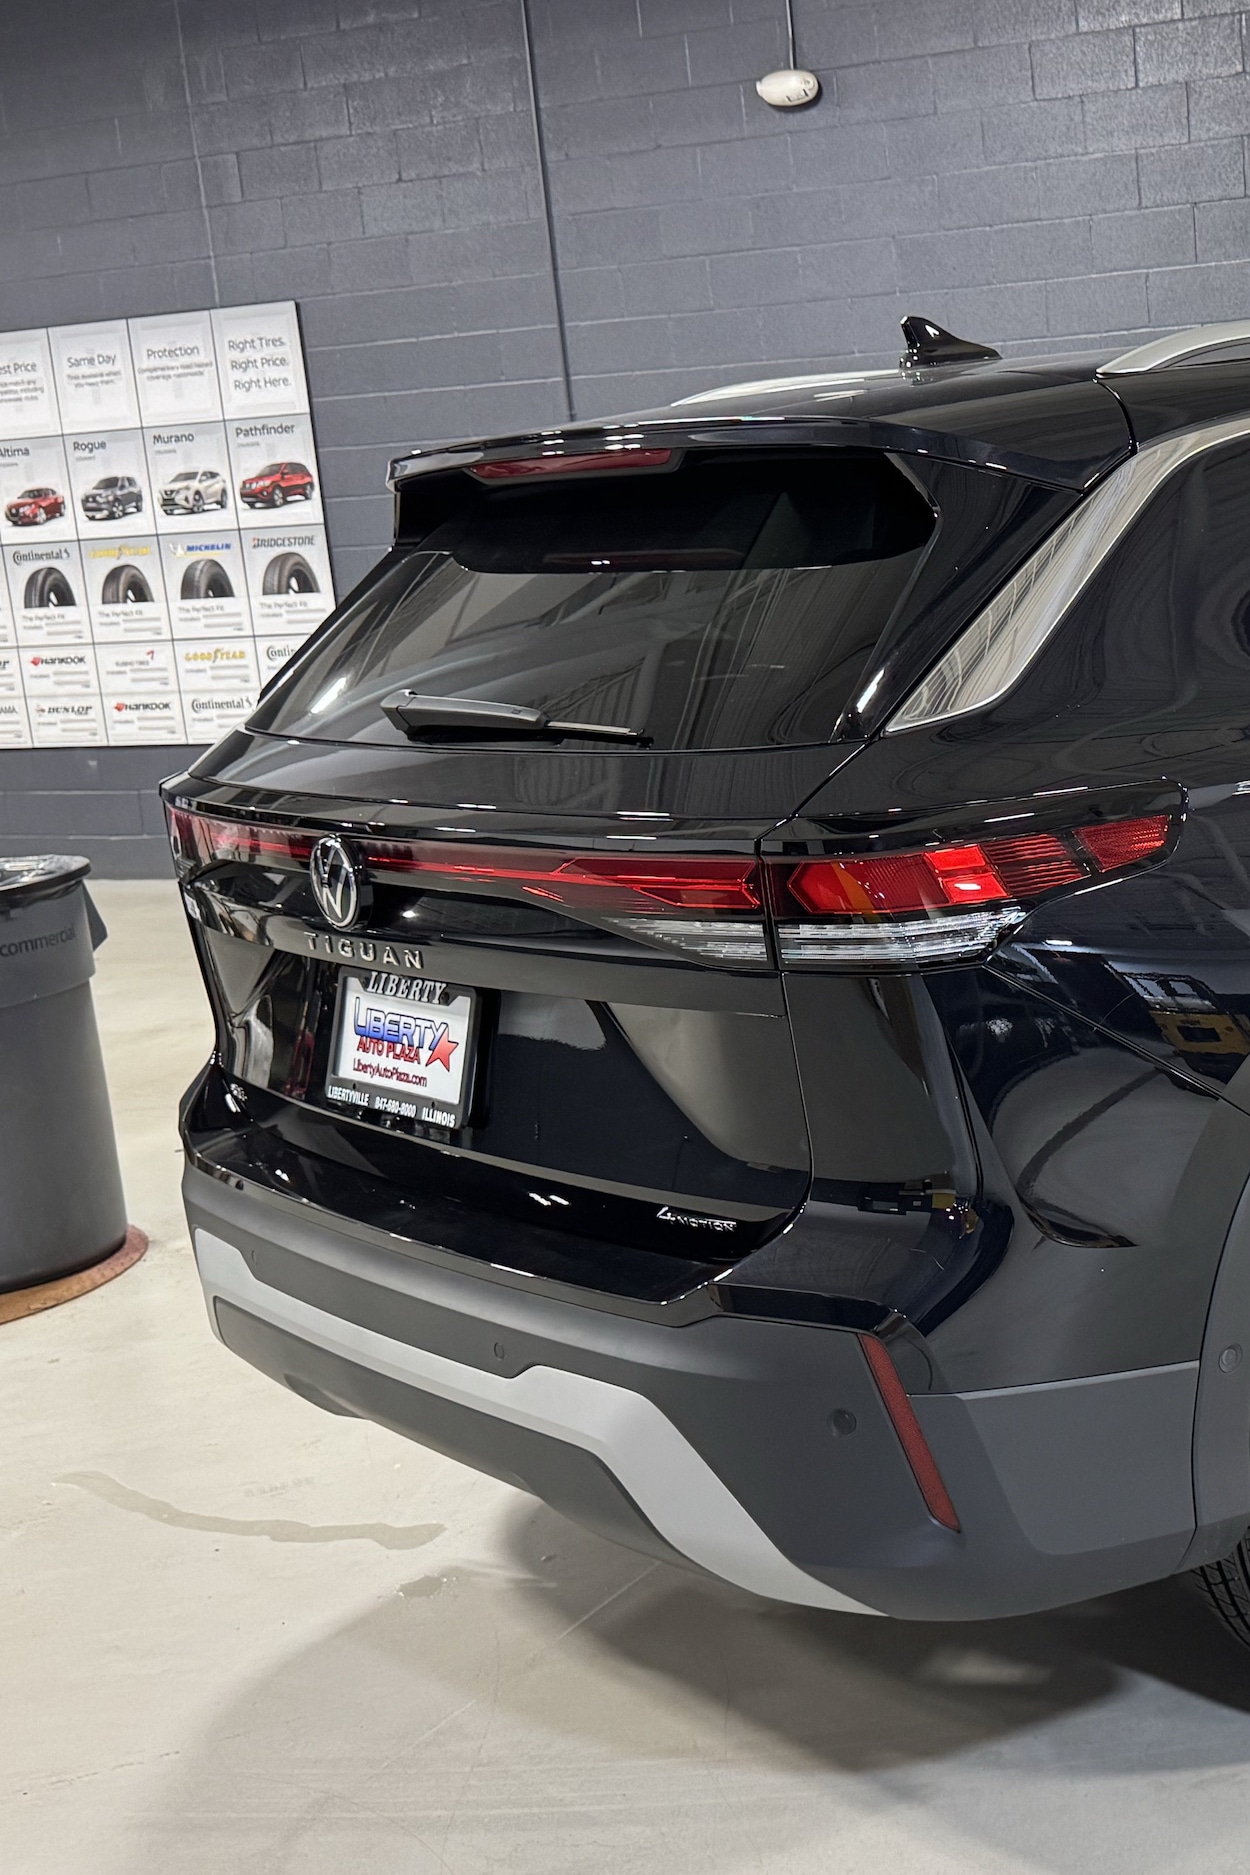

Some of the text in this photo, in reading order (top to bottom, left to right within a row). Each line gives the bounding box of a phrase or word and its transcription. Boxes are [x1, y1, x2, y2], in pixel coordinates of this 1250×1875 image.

[146, 345, 200, 360] Protection
[228, 336, 286, 354] Right Tires.
[13, 361, 37, 374] Price
[67, 353, 116, 369] Same Day
[231, 356, 289, 373] Right Price.
[234, 376, 292, 392] Right Here.
[153, 432, 195, 445] Murano
[235, 423, 295, 438] Pathfinder
[73, 440, 107, 453] Rogue
[186, 542, 232, 552] MICHELIN
[252, 534, 316, 549] BRIDGESTONE
[13, 549, 63, 566] Continental
[185, 647, 246, 663] GOODYEAR
[267, 644, 297, 661] Contin
[47, 705, 93, 716] DUNLOP
[192, 697, 245, 714] Continental
[303, 931, 425, 970] TIGUAN
[366, 970, 446, 1005] LIBERTY
[353, 996, 448, 1051] LIBERTY
[357, 1036, 421, 1064] AUTO PLAZA
[328, 1086, 369, 1106] LIBERTYVILLE
[422, 1107, 456, 1128] ILLINOIS
